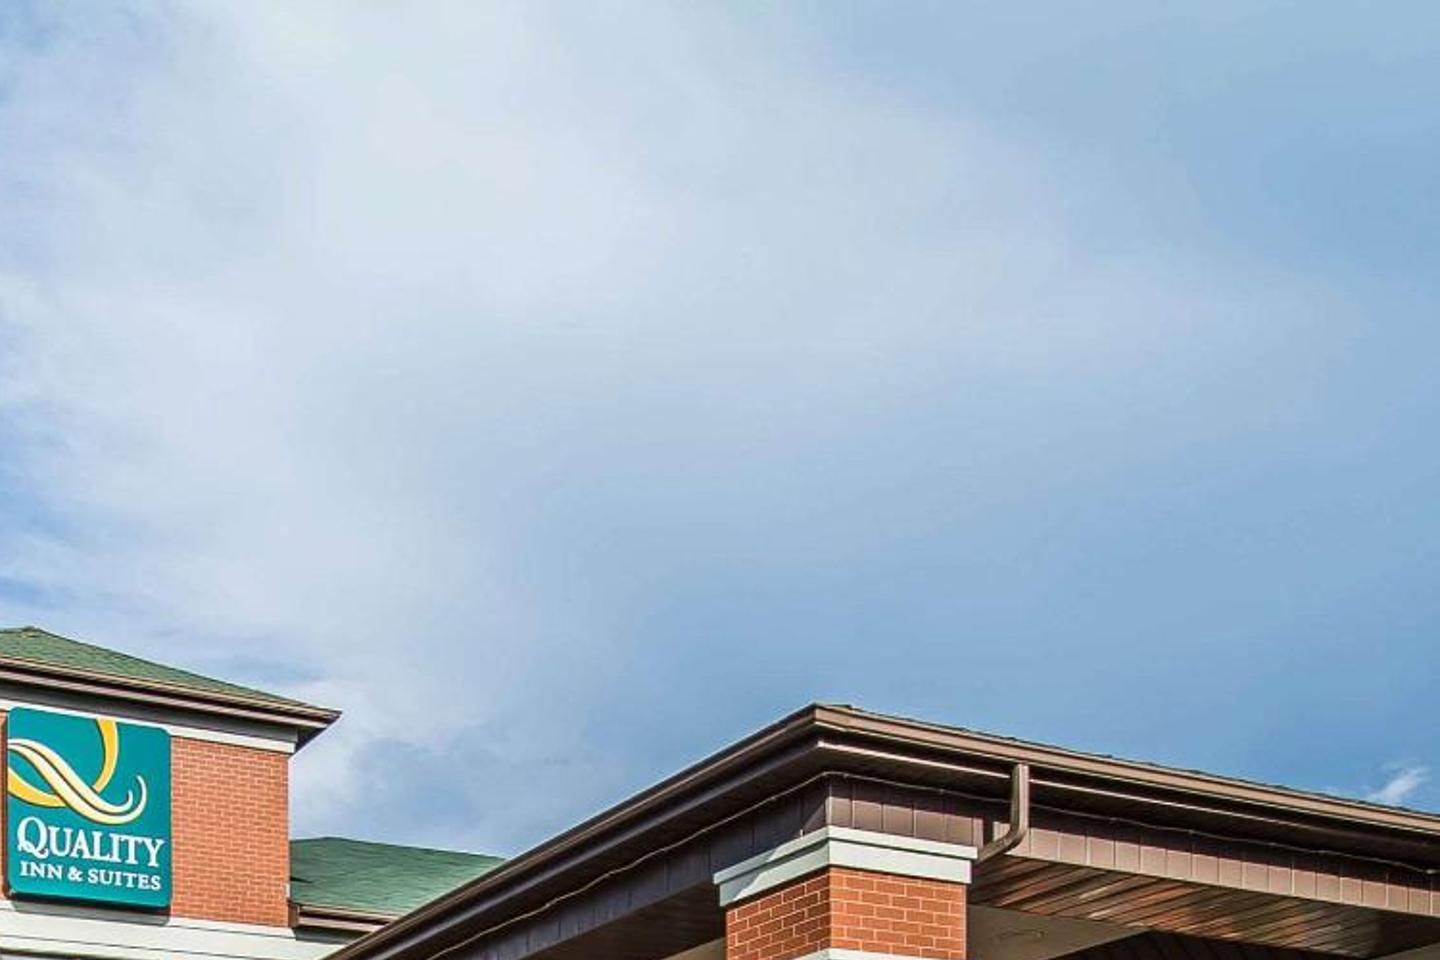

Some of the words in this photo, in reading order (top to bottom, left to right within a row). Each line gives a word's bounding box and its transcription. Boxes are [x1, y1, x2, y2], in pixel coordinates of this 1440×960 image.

[16, 816, 165, 868] QUALITY
[19, 860, 63, 881] INN
[67, 866, 83, 882] &
[87, 869, 161, 891] SUITES
